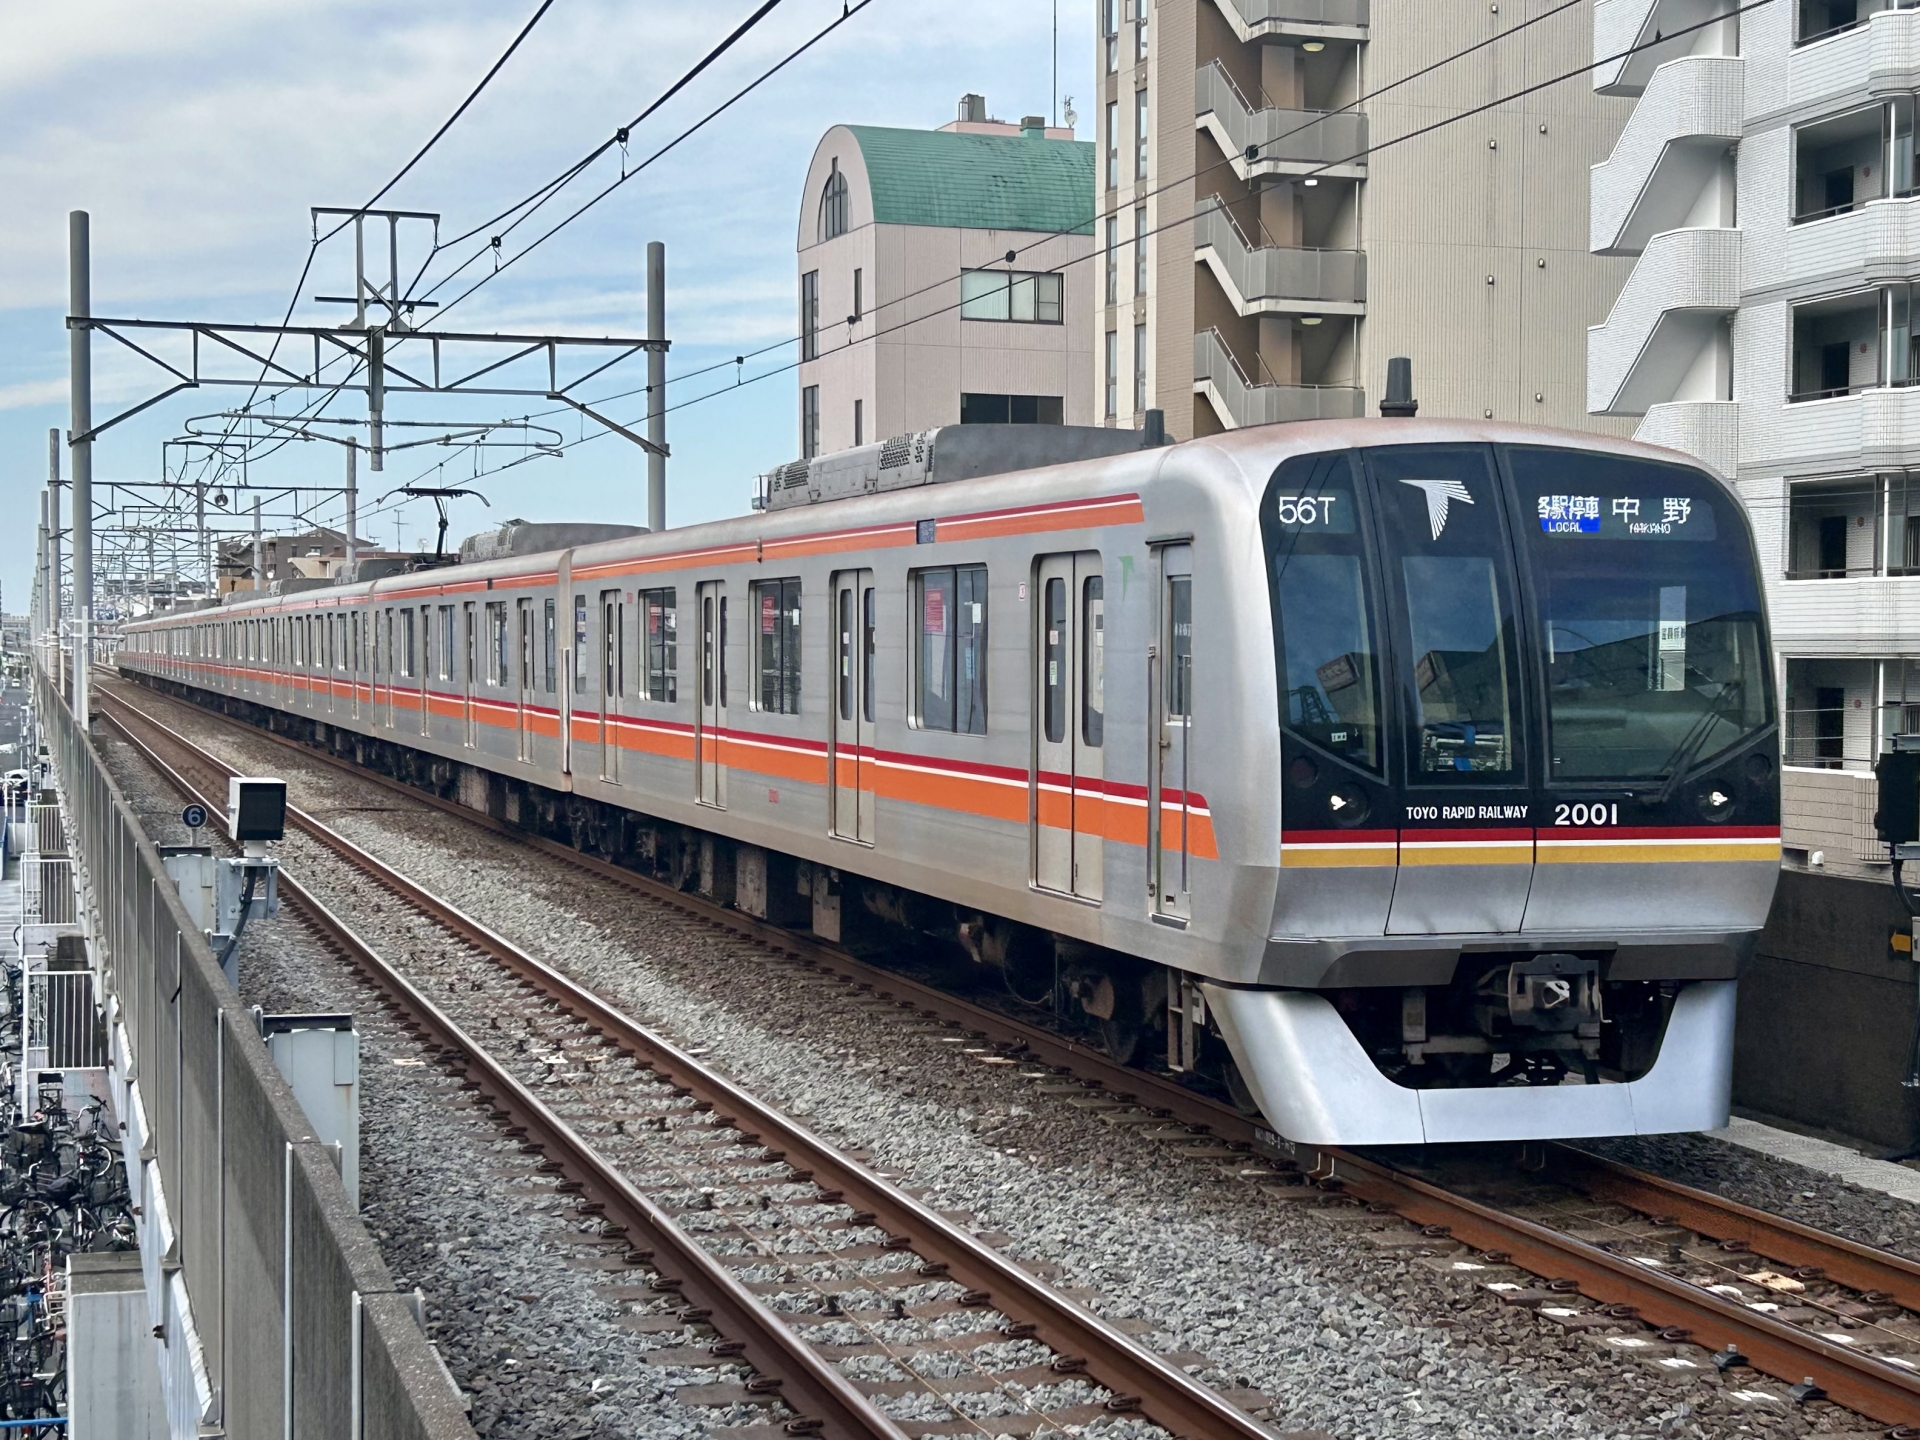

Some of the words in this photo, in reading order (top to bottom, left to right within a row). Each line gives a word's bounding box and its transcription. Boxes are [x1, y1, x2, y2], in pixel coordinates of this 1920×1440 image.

[1279, 496, 1336, 525] 56T
[1537, 494, 1600, 520] 各駅停車
[1548, 521, 1583, 533] LOCAL
[188, 807, 201, 825] 6
[1405, 806, 1438, 820] TOYO
[1442, 806, 1475, 819] RAPID
[1478, 805, 1529, 819] RAILWAY
[1554, 803, 1618, 826] 2001
